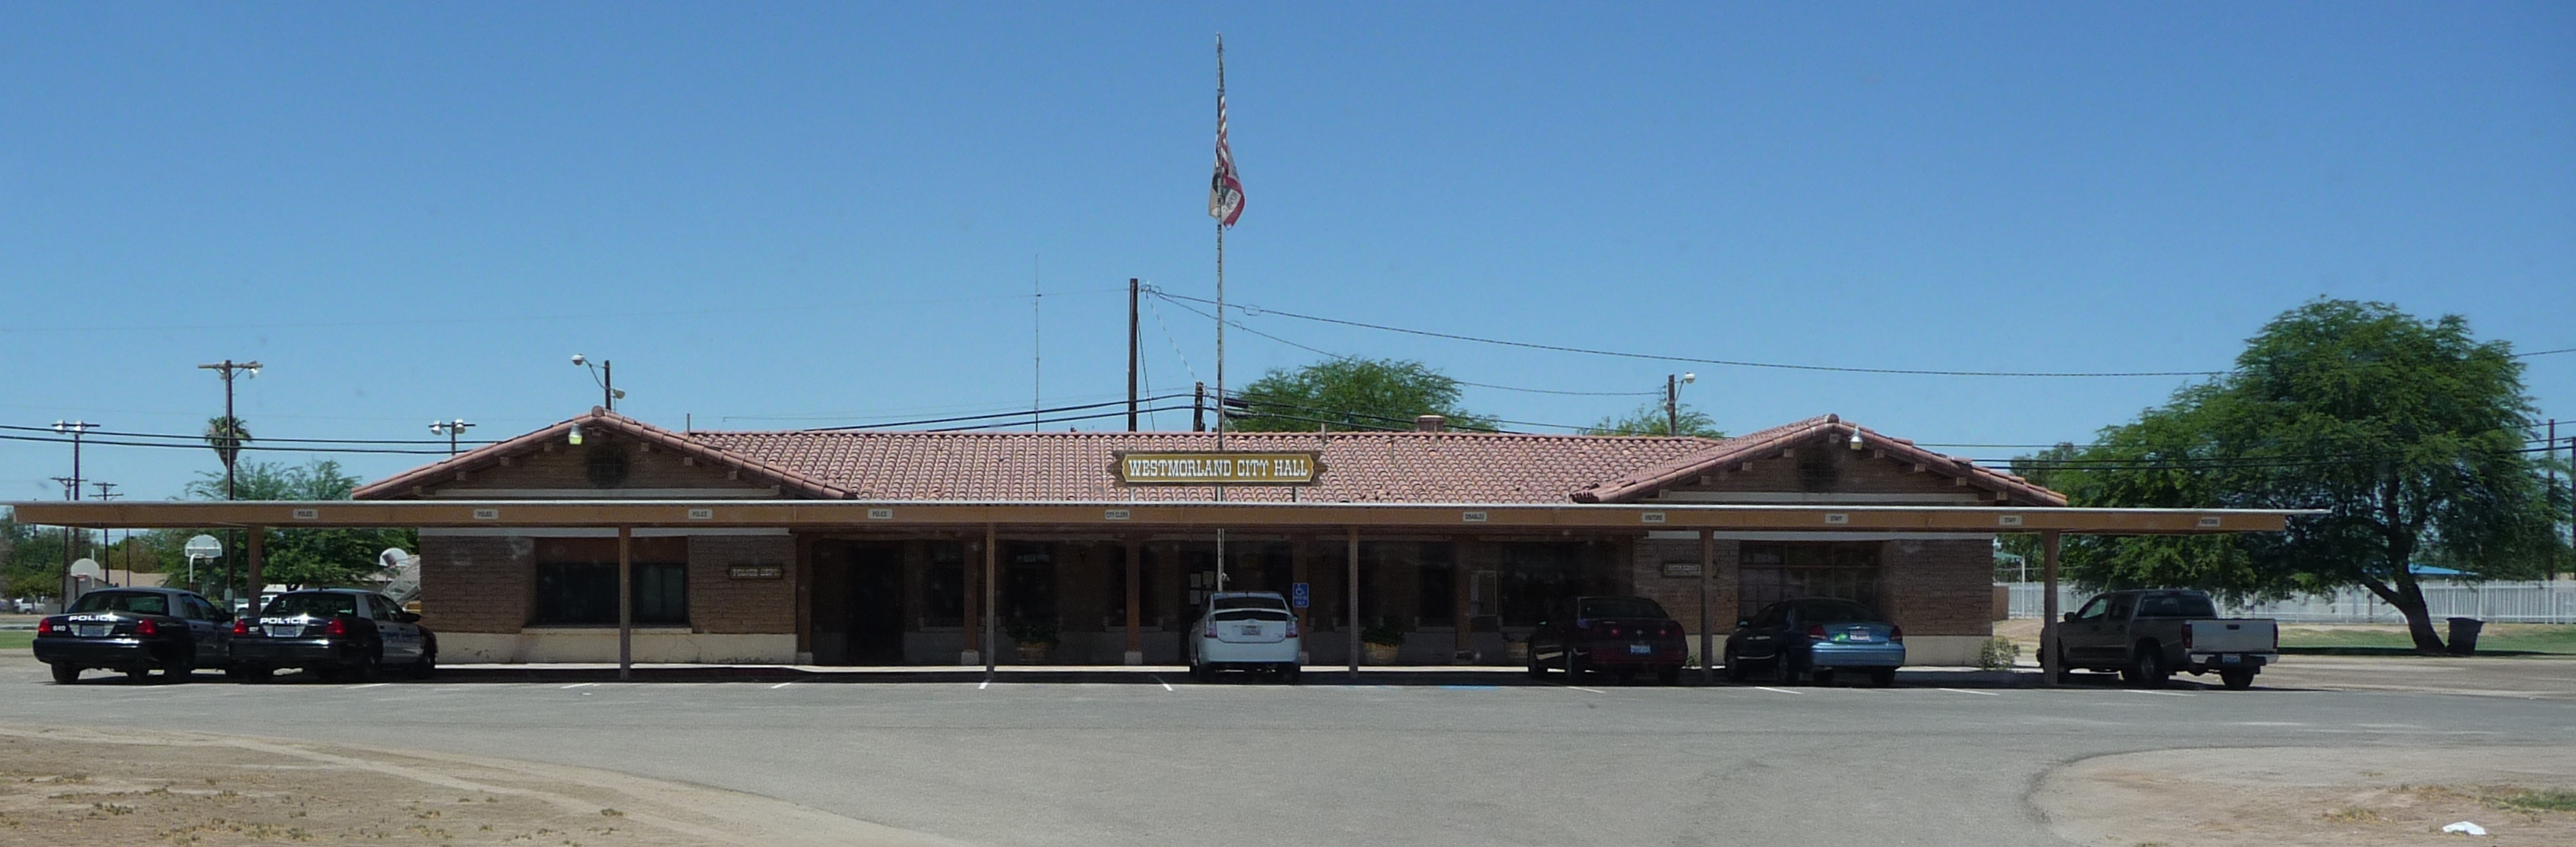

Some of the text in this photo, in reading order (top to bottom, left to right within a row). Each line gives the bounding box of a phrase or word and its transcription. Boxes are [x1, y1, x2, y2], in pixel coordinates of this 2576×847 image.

[1128, 459, 1308, 477] WESTMORLAND CITY HALL
[733, 568, 758, 576] POLICE
[259, 617, 309, 625] POLICE
